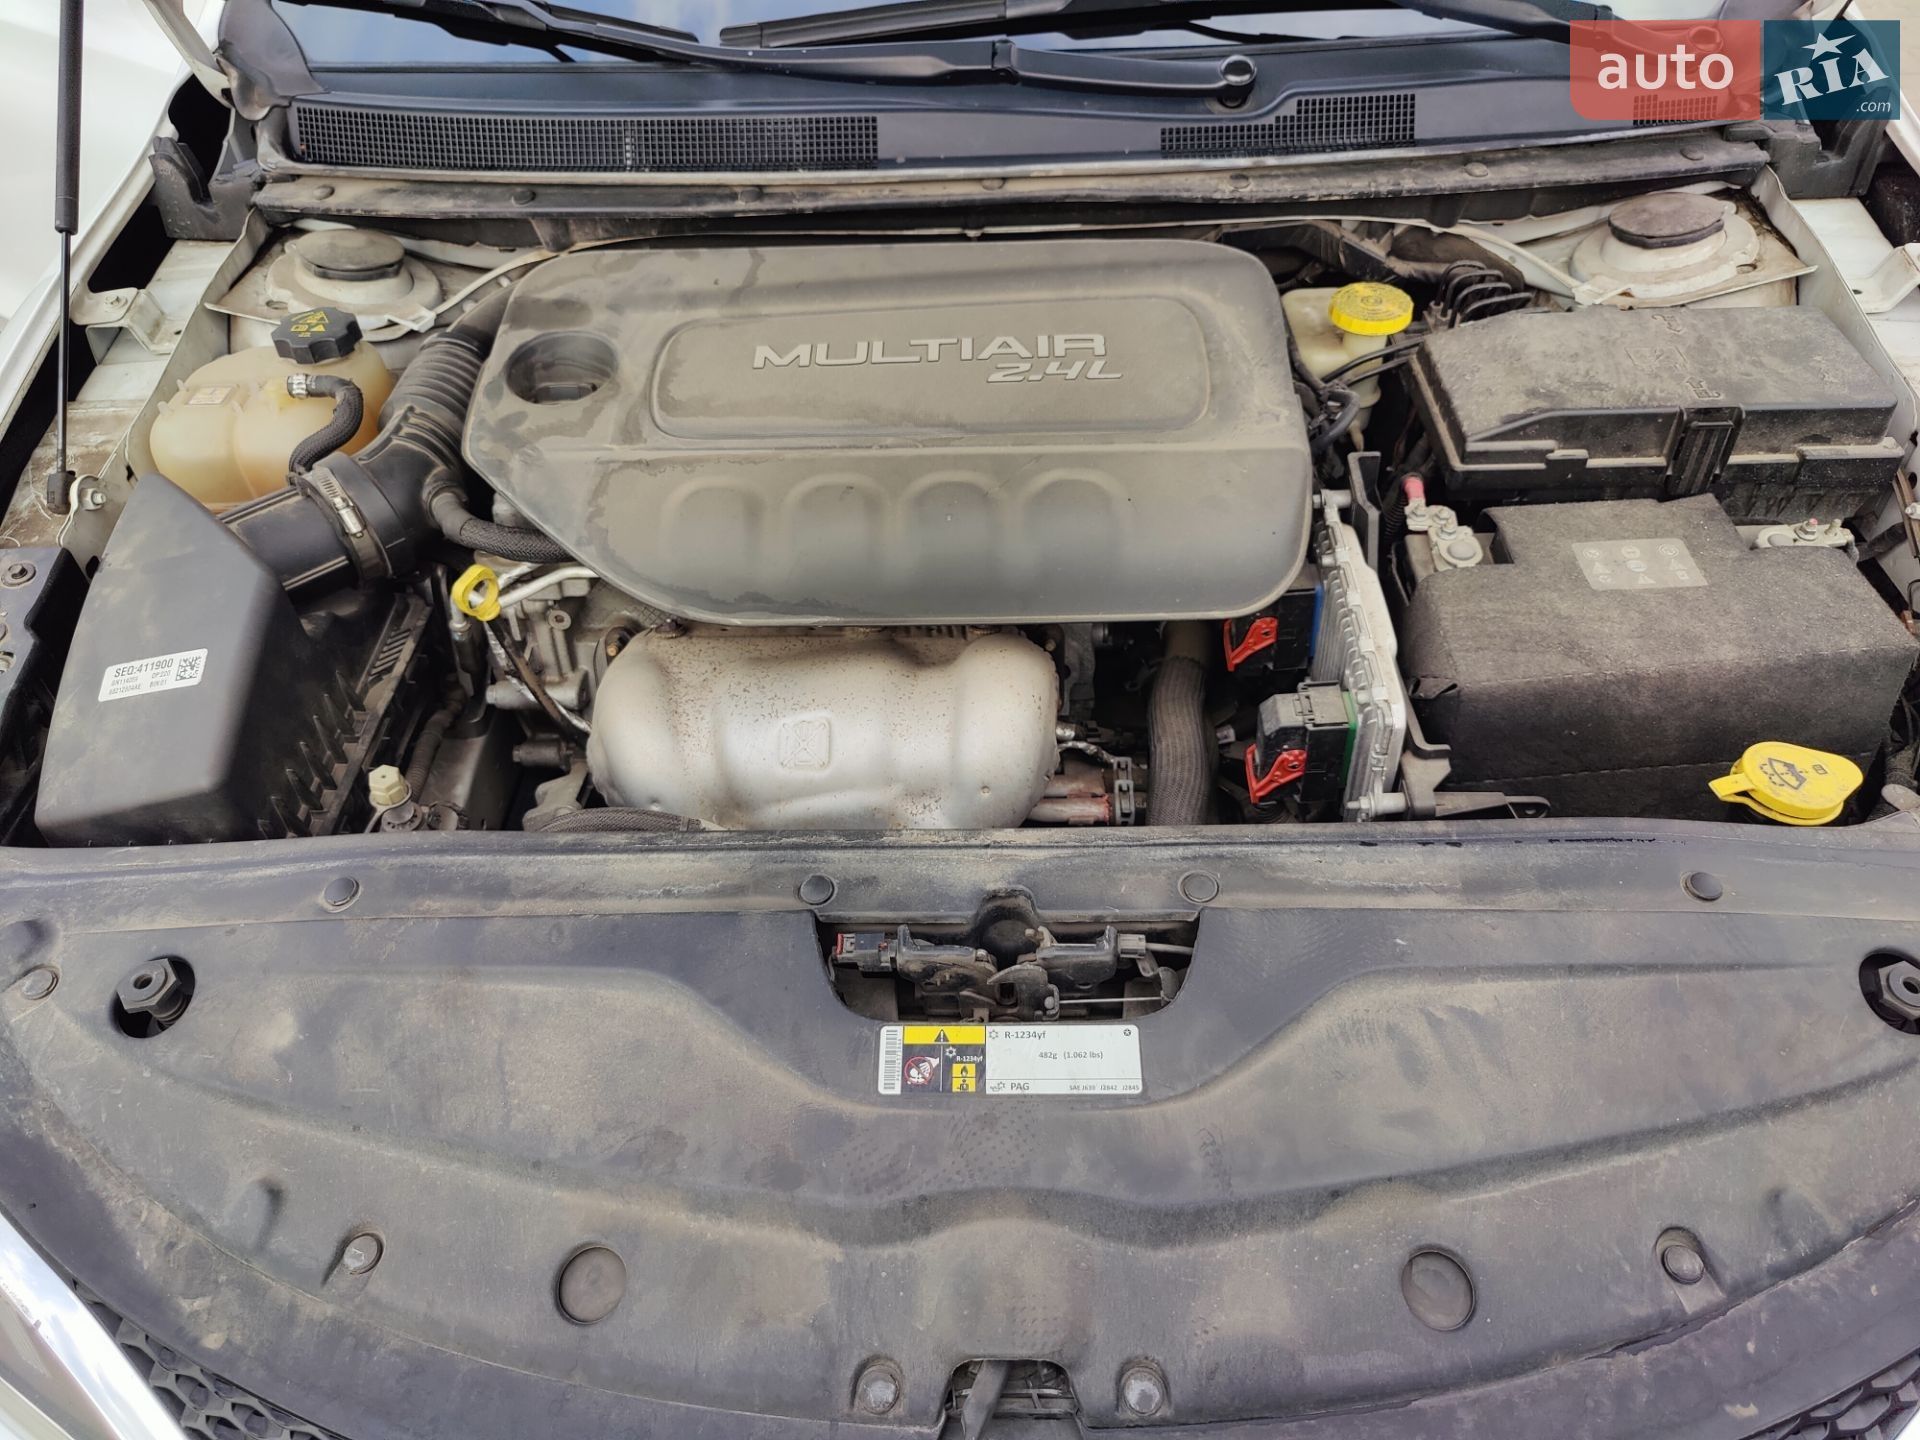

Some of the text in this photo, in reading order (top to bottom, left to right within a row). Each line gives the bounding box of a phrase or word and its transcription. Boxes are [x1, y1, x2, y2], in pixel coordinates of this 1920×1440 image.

[752, 333, 1106, 369] MULTIAIR
[986, 359, 1123, 384] 2.4L
[114, 658, 174, 678] SEQ:411900
[1004, 1030, 1046, 1040] R-1234yf
[956, 1055, 984, 1064] R-1234yf
[1038, 1050, 1104, 1060] 482g (1.062 lbs)
[1010, 1082, 1030, 1091] PAG
